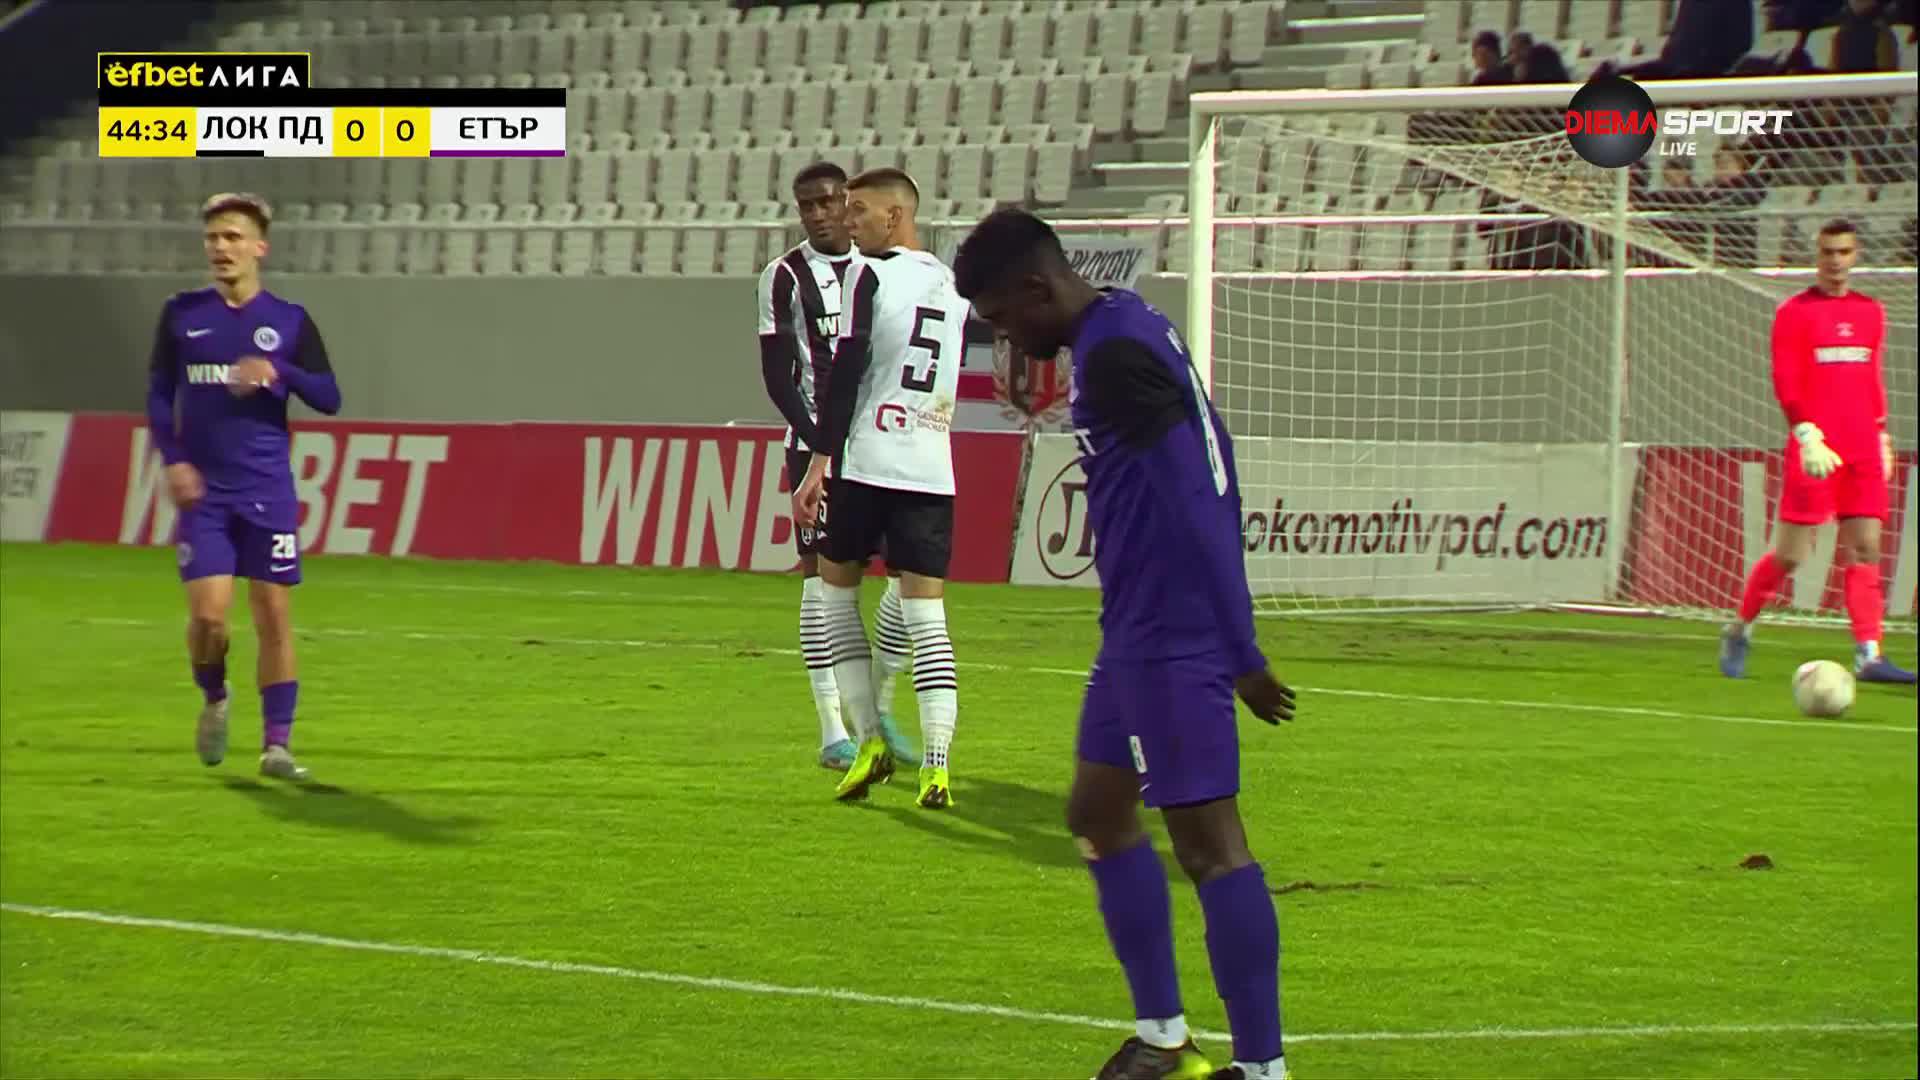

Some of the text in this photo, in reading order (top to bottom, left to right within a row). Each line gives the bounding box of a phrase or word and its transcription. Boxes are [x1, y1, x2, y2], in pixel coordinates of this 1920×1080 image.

[901, 306, 946, 392] 5
[271, 534, 296, 559] 28
[1240, 496, 1607, 571] okomotivpd.com
